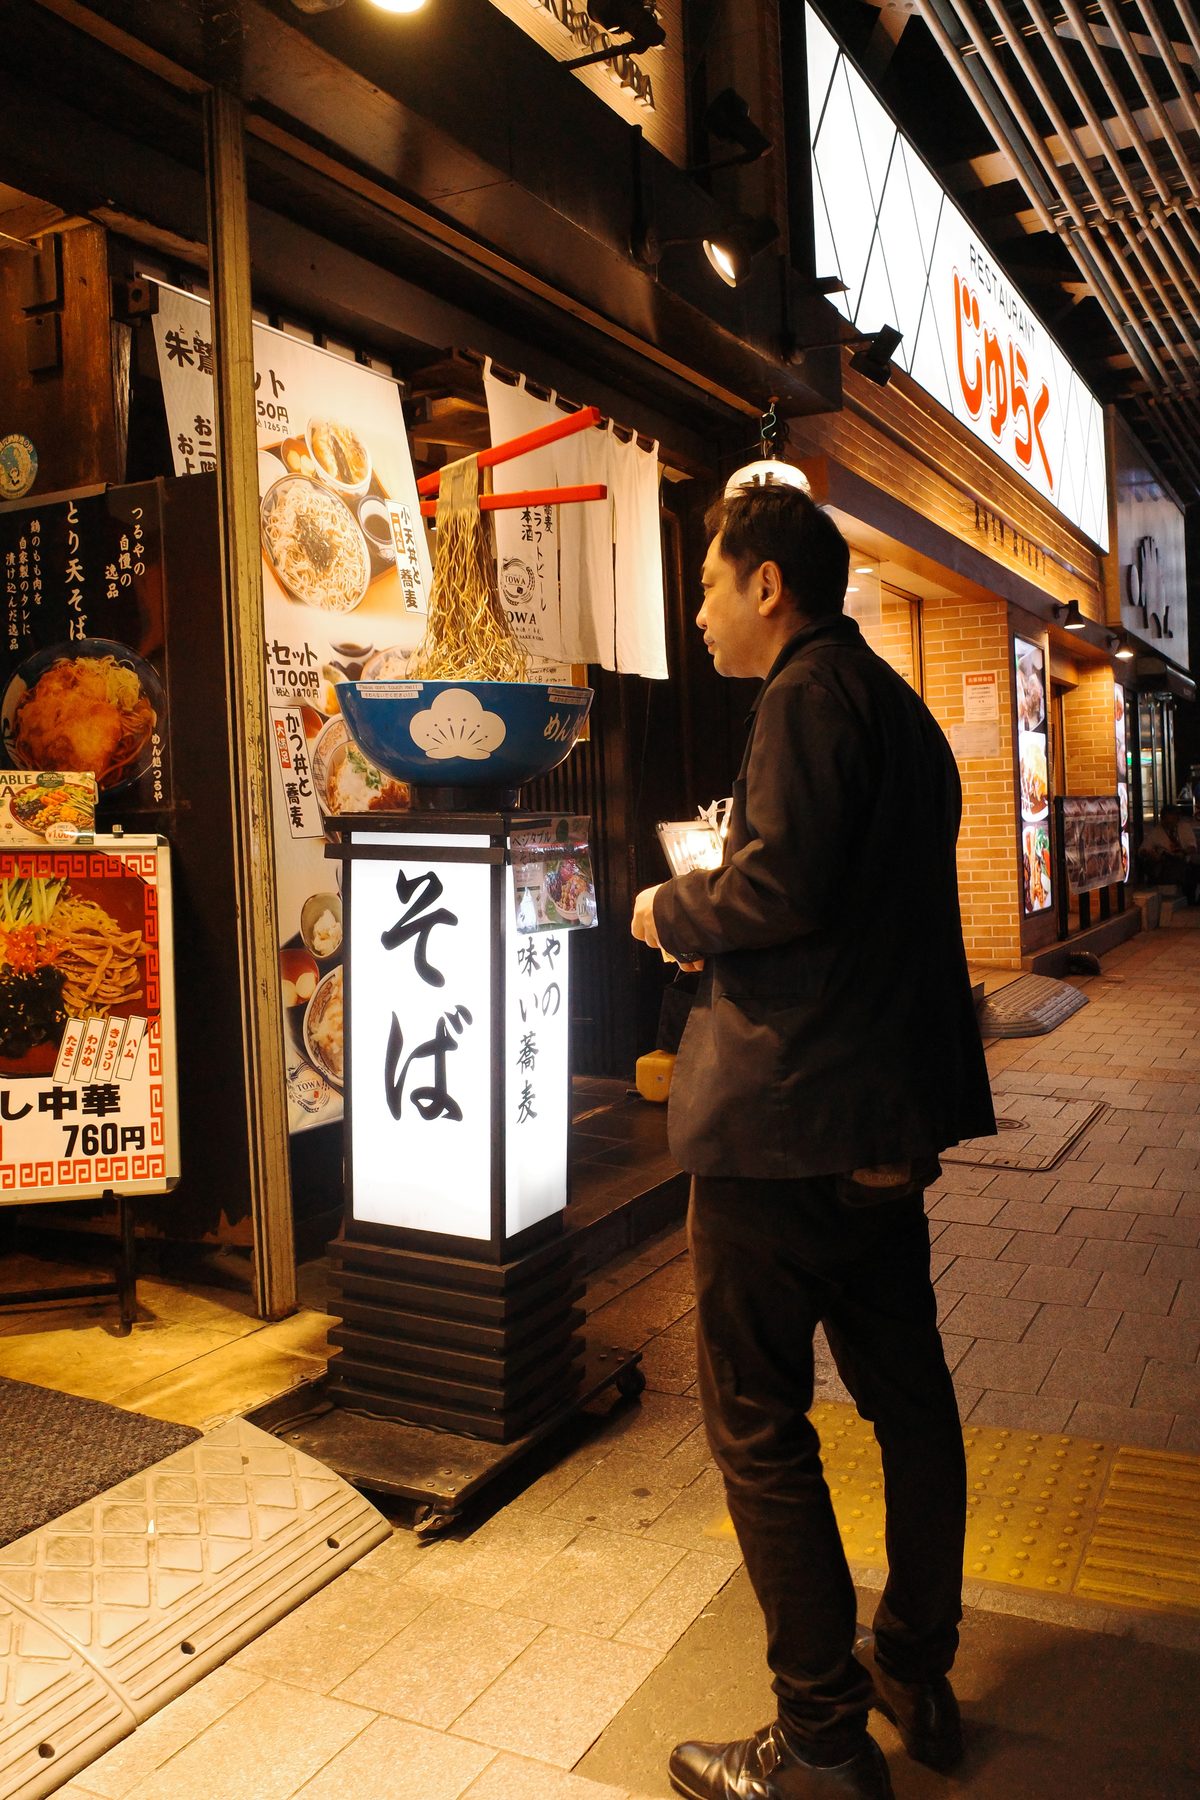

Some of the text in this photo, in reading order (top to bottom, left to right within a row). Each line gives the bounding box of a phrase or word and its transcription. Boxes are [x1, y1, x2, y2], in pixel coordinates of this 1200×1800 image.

[969, 243, 1036, 350] RESTAURANT
[952, 266, 1055, 496] じゅらく
[257, 400, 290, 424] 50円
[131, 507, 146, 576] つるやの
[400, 507, 421, 585] 小天丼と
[521, 506, 534, 541] 本酒
[65, 501, 88, 641] とり天そば
[105, 563, 119, 599] 逸品
[118, 534, 132, 587] 自慢の
[505, 575, 526, 586] TOWA
[534, 504, 547, 612] ラフトビール
[5, 551, 19, 651] 漬け込んだ逸品
[18, 536, 31, 636] 自家製のタレに
[400, 568, 418, 609] 蕎麦
[506, 610, 537, 625] OWA
[270, 668, 320, 689] 1700円
[151, 733, 163, 803] めん処つるや
[286, 713, 312, 798] かつ丼と
[285, 782, 304, 829] 蕎麦
[380, 869, 474, 1122] そば
[542, 934, 562, 1018] やの
[81, 1034, 98, 1067] わかめ
[103, 1028, 121, 1071] きゅうり
[124, 1038, 137, 1060] ハム
[516, 936, 540, 1125] 味い蕎麦
[0, 1083, 121, 1121] し中華
[62, 1122, 146, 1158] 760円
